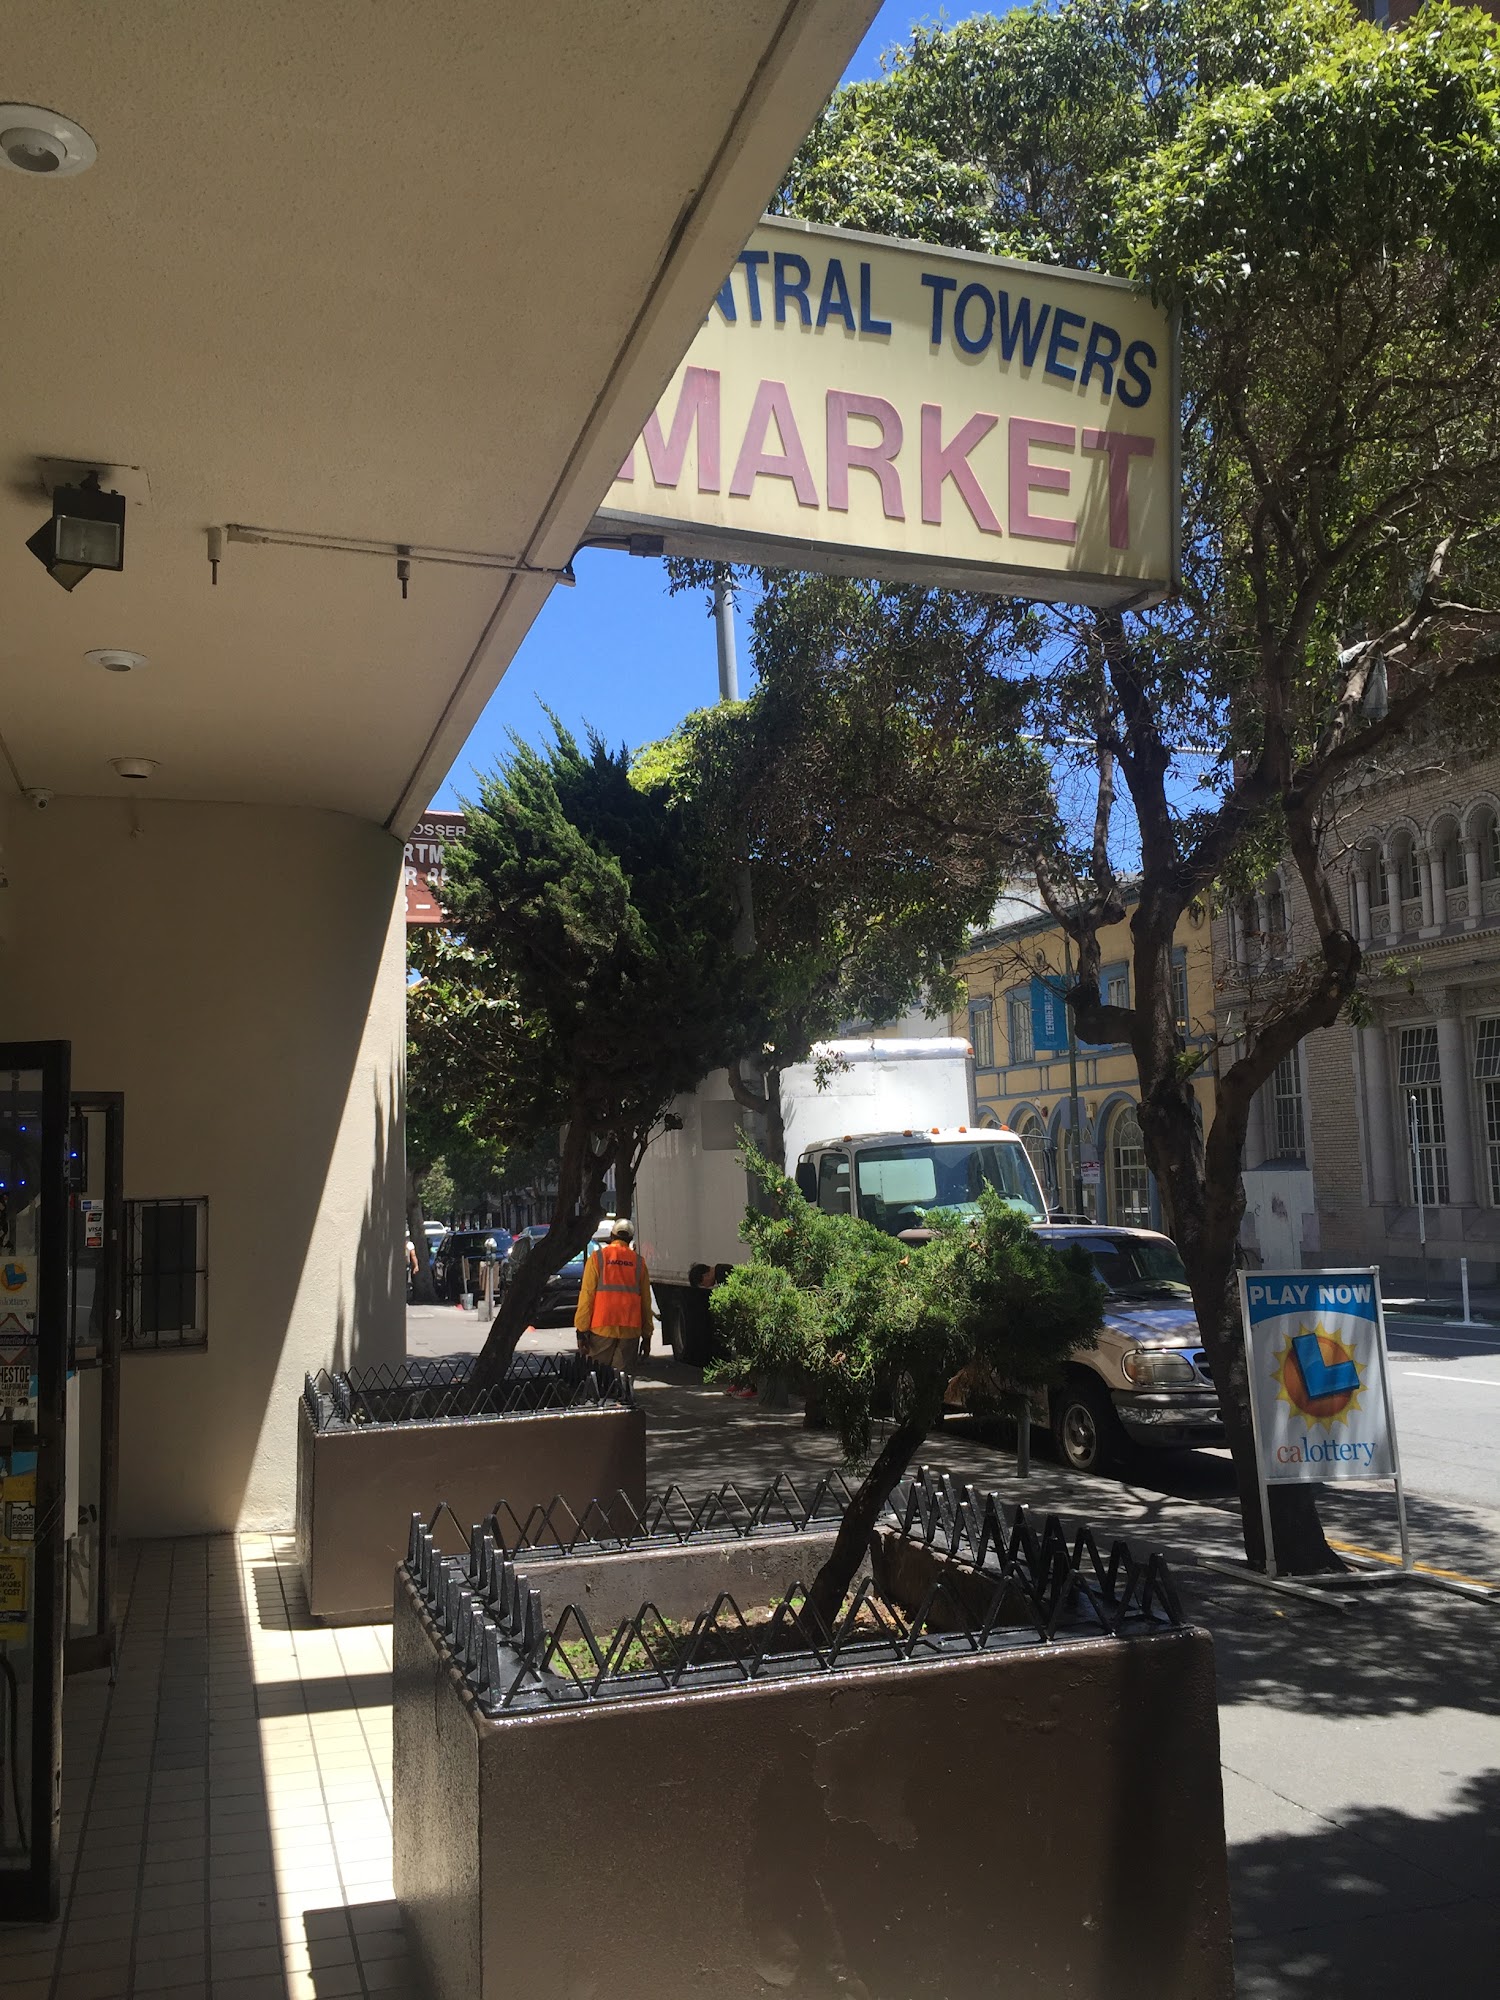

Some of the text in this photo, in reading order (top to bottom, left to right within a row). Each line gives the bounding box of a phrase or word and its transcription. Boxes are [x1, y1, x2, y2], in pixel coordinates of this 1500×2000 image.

[921, 273, 1158, 408] TOWERS
[617, 365, 1156, 550] MARKET
[1249, 1283, 1372, 1306] PLAY NOW
[1276, 1436, 1376, 1467] calottery
